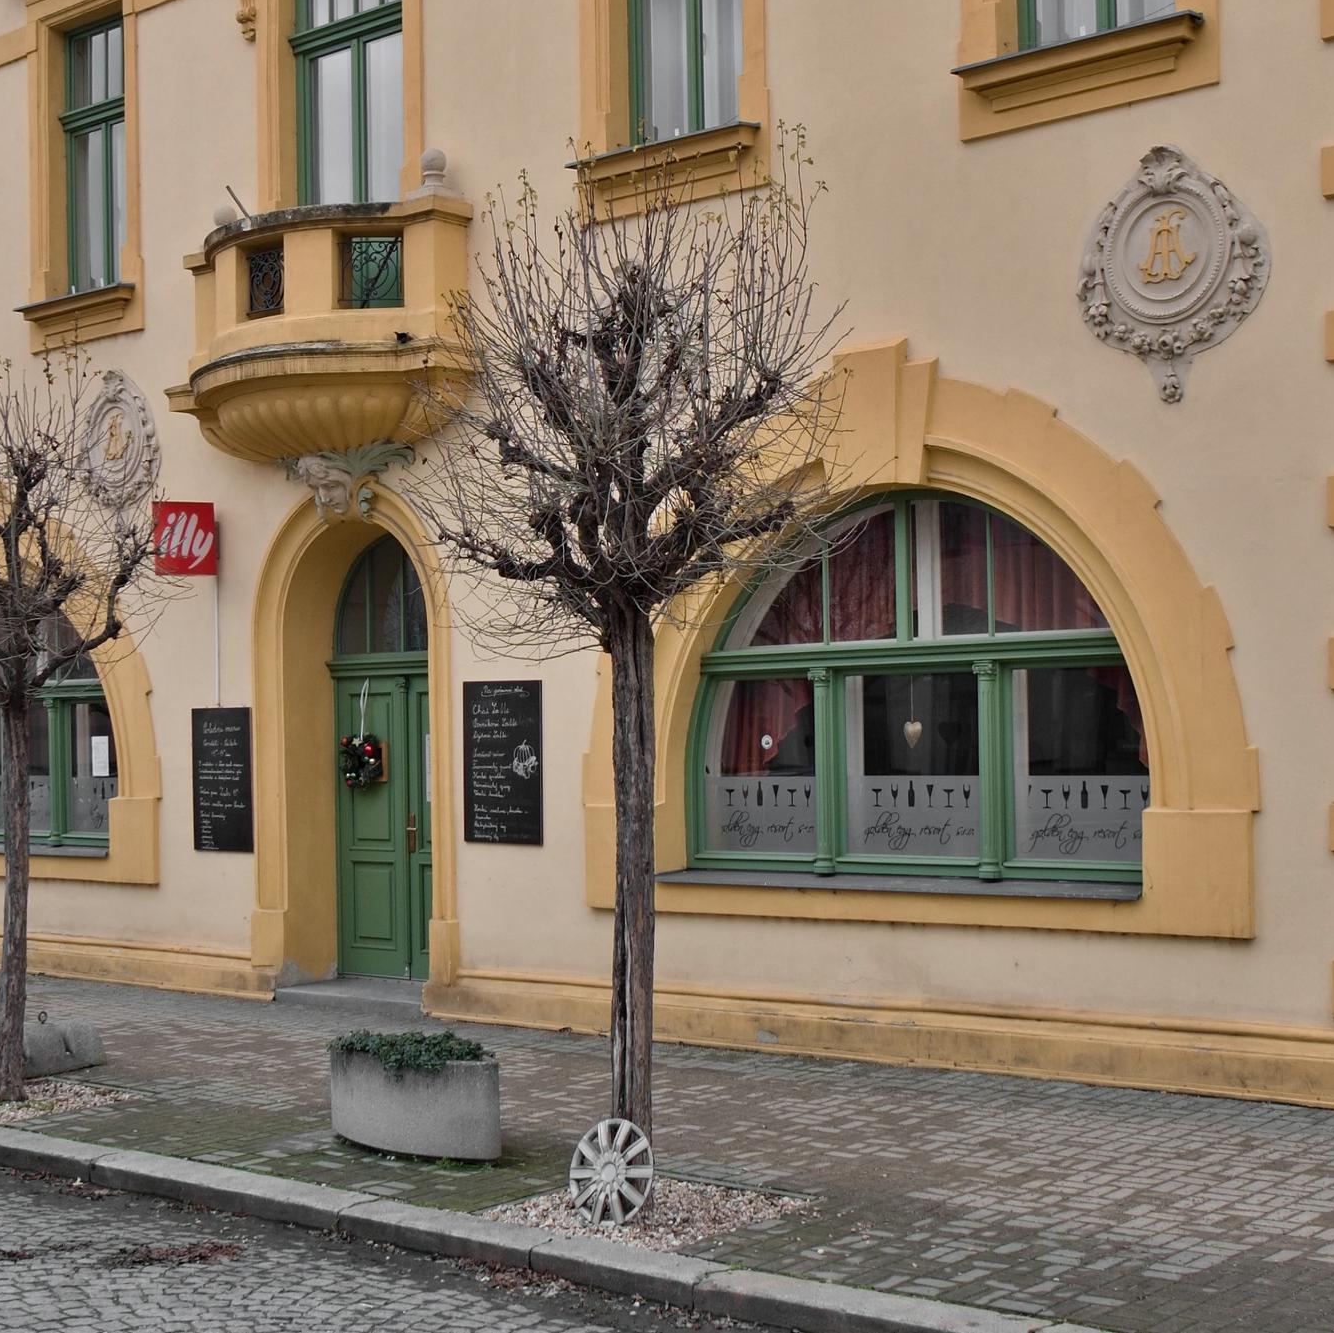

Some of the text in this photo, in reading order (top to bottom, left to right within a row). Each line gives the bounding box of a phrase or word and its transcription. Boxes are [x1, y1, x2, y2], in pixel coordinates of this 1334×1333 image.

[159, 511, 214, 569] illy
[919, 818, 951, 845] resort
[1092, 820, 1127, 849] resort
